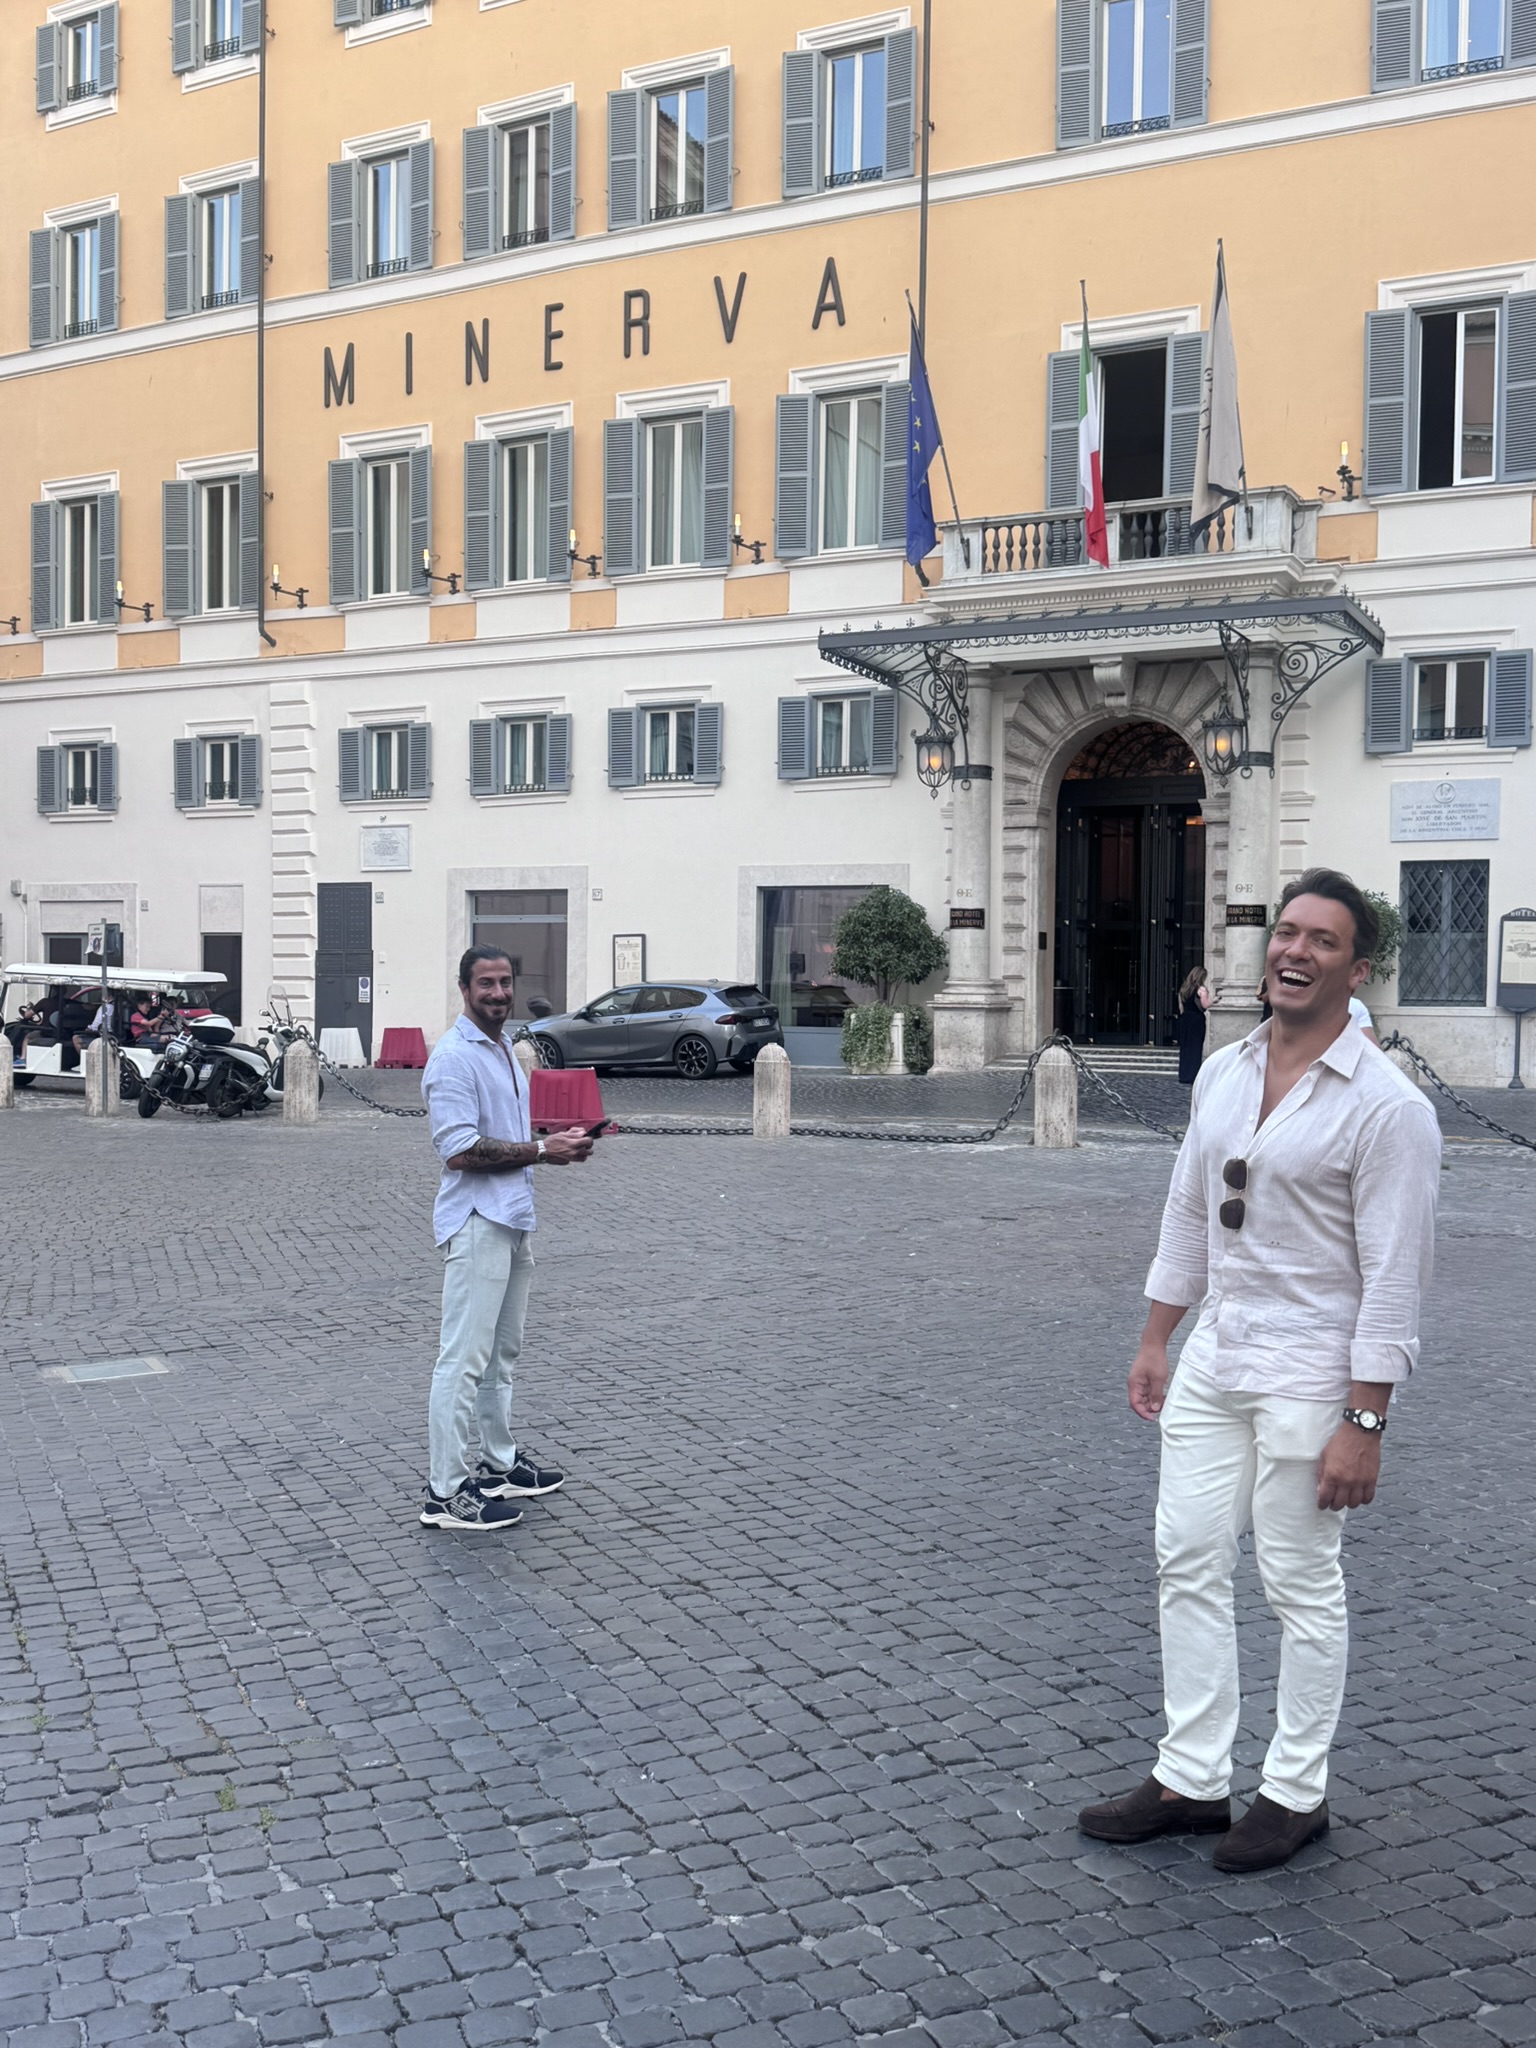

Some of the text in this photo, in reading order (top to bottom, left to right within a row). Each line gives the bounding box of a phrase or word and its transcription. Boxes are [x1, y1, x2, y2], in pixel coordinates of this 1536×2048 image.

[324, 257, 846, 408] MINERVA
[964, 910, 981, 918] HOTEL
[1244, 906, 1263, 914] HOTEL
